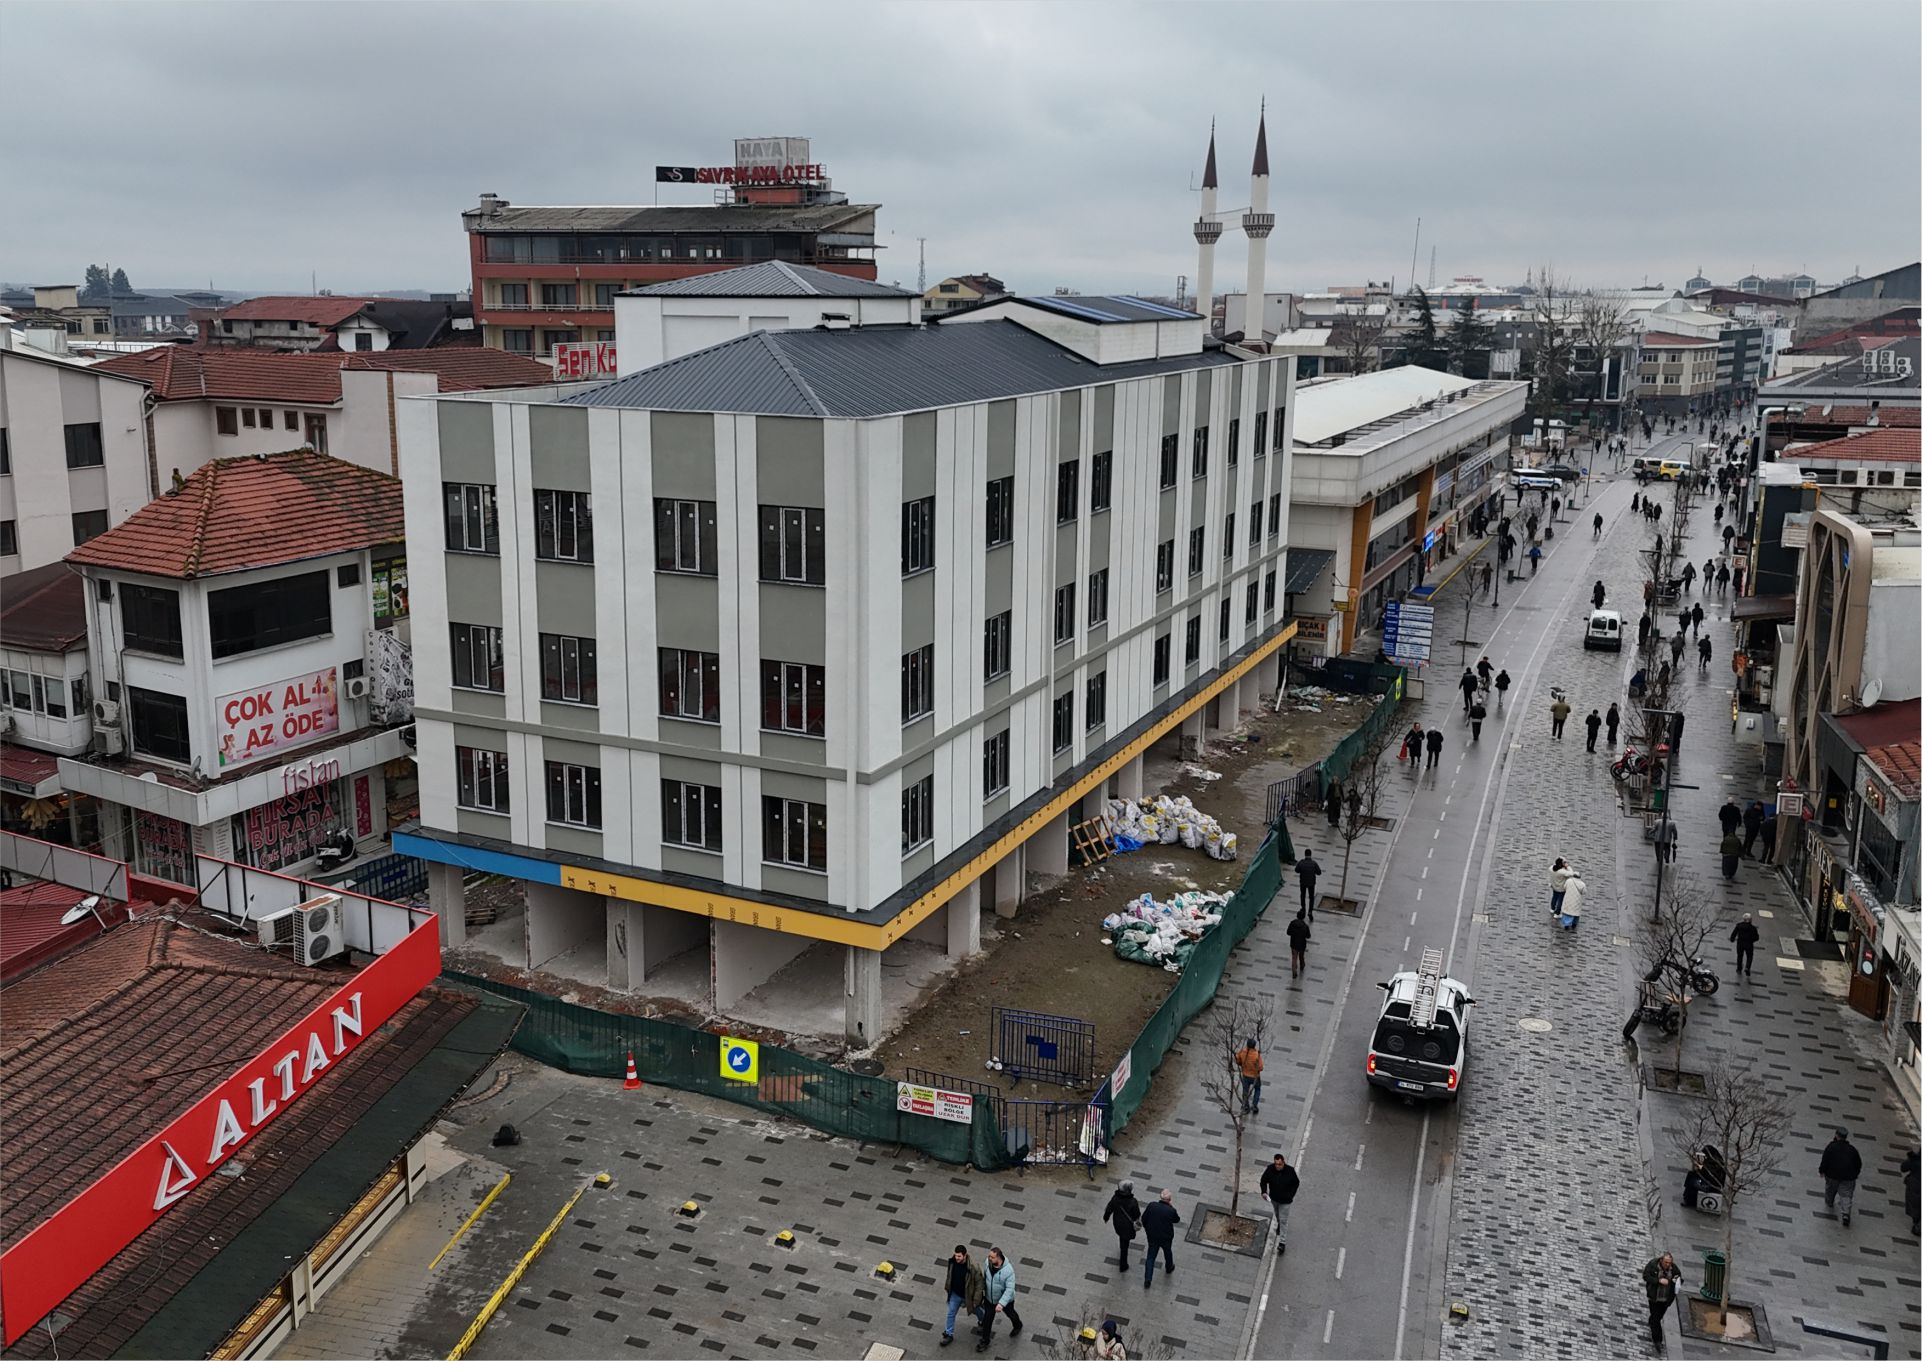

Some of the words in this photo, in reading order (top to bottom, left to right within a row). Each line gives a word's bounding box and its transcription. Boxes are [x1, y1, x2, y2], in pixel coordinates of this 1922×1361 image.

[782, 164, 826, 181] OTEL
[558, 344, 591, 376] Sen
[224, 691, 274, 729] ÇOK
[283, 683, 311, 710] AL
[246, 724, 274, 750] AZ
[282, 709, 324, 739] ÖDE
[281, 758, 340, 796] fistan
[251, 803, 336, 851] BURADA
[206, 991, 363, 1165] ALTAN
